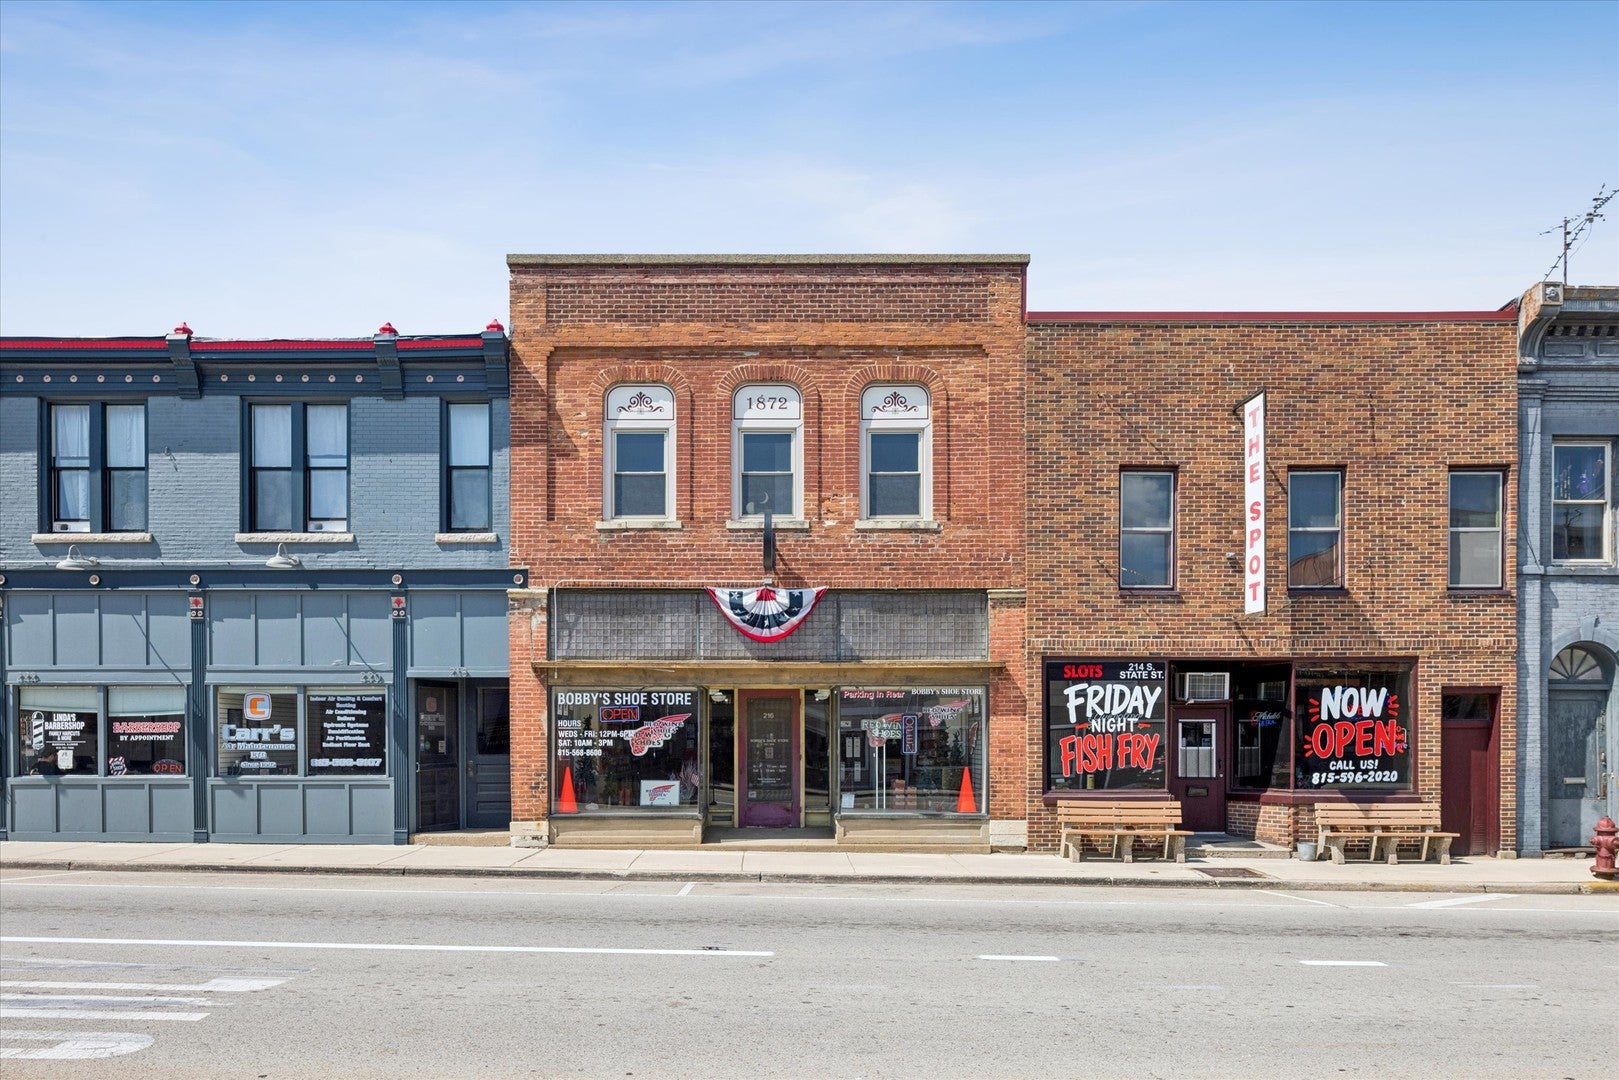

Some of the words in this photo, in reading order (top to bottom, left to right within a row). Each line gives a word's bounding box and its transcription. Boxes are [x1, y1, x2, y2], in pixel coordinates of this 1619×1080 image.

[747, 395, 787, 410] 1872
[1248, 405, 1260, 484] THE
[1248, 501, 1261, 601] SPOT
[1063, 664, 1103, 678] SLOTS
[1128, 663, 1144, 671] 214
[1146, 663, 1155, 671] S.
[1119, 670, 1149, 679] STATE
[1150, 670, 1164, 679] ST.
[558, 692, 611, 705] BOBBY'S
[614, 692, 648, 705] SHOE
[651, 692, 692, 705] STORE
[843, 691, 874, 699] Parking
[1063, 683, 1162, 723] FRIDAY
[1321, 685, 1387, 720] NOW
[53, 713, 77, 721] LINDA'S
[602, 708, 638, 720] OPEN
[44, 721, 85, 730] BARBERSHOP
[113, 722, 181, 733] BARBERSHOP
[1091, 717, 1139, 732] NIGHT
[222, 724, 296, 741] Carr's
[1312, 719, 1396, 758] OPEN
[1059, 733, 1112, 777] FISH
[1117, 733, 1160, 770] FRY
[153, 764, 182, 773] OPEN
[1329, 760, 1355, 770] CALL
[1360, 759, 1378, 769] US!
[1311, 771, 1398, 784] 815-596-2020
